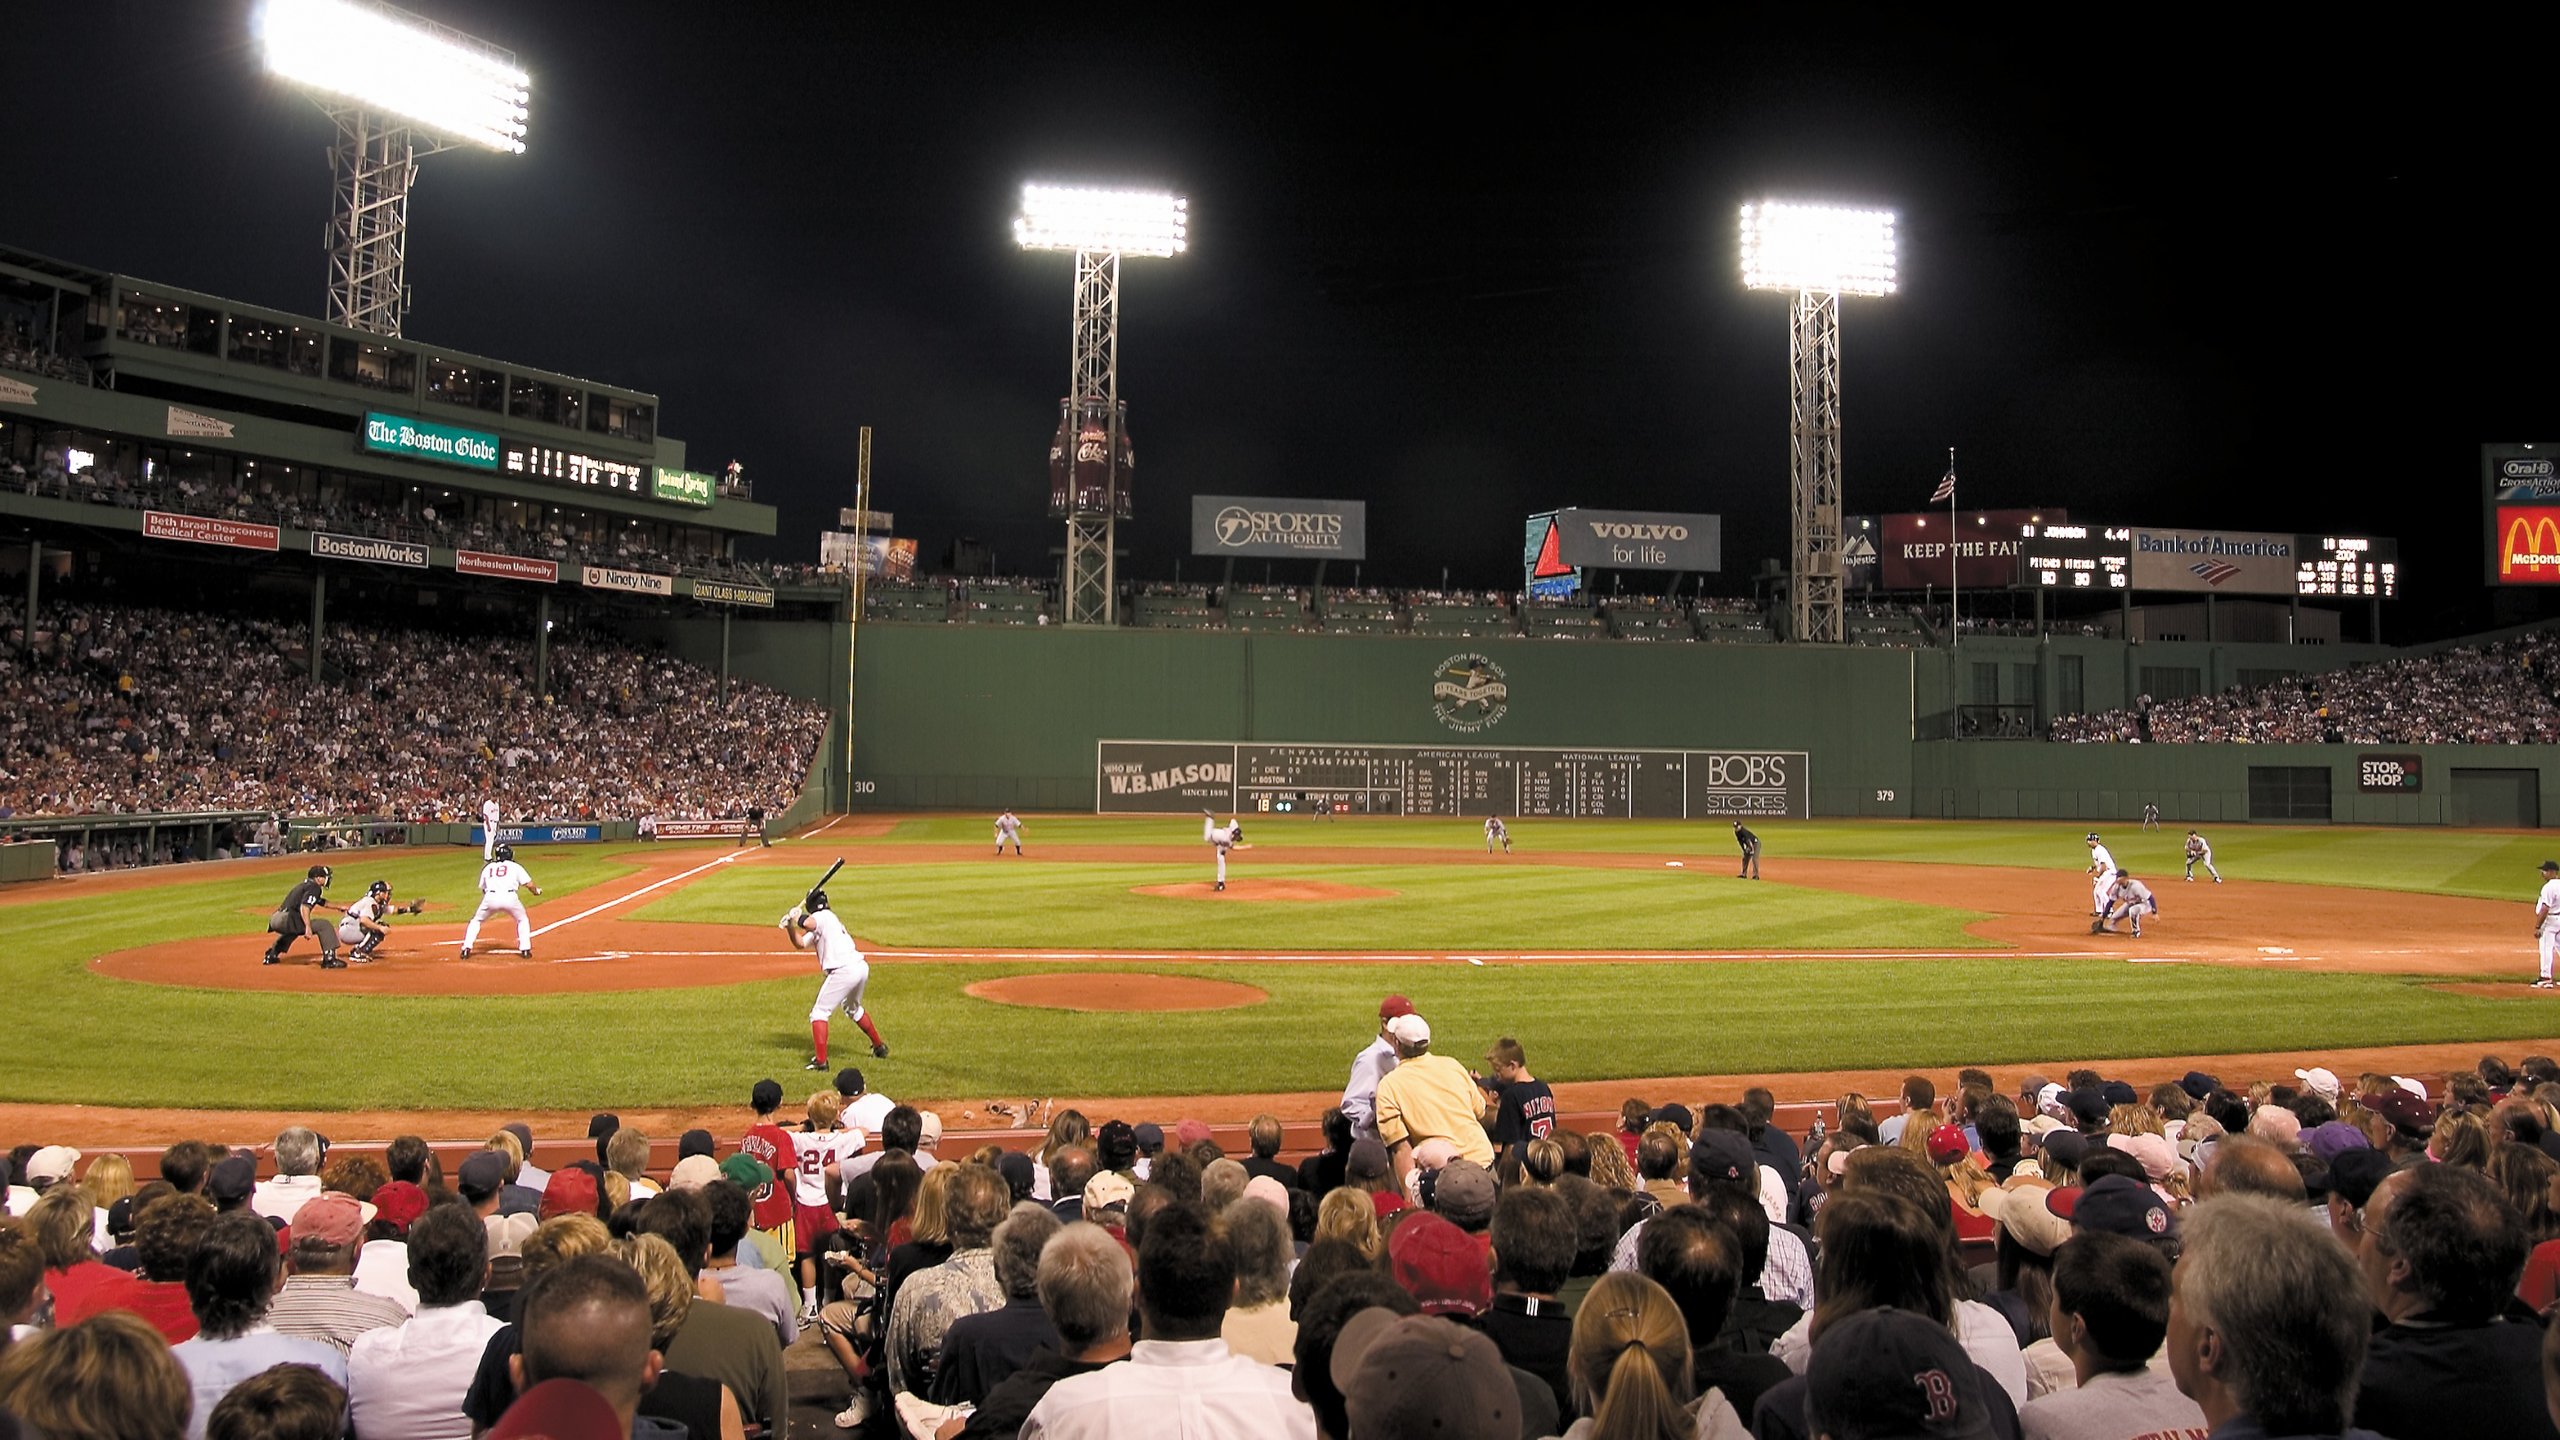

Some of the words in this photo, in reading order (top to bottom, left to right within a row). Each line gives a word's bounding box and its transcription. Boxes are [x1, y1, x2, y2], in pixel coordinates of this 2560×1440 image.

[368, 420, 397, 444] The
[399, 425, 452, 454] Boston
[454, 436, 496, 461] Globe
[627, 466, 641, 477] OUT
[2507, 462, 2550, 474] Oral-B
[590, 468, 599, 484] 2
[610, 472, 619, 487] 0
[629, 475, 637, 491] 2
[684, 473, 708, 498] Spring
[151, 515, 178, 528] Beth
[179, 519, 210, 532] Israel
[213, 522, 275, 540] Deaconess
[1251, 511, 1342, 534] SPORTS
[1589, 522, 1689, 541] VOLVO
[150, 525, 196, 540] Medical
[197, 530, 237, 544] Center
[1251, 532, 1341, 545] AUTHORITY
[318, 535, 424, 565] BostonWorks
[1612, 543, 1635, 564] for
[1640, 545, 1666, 565] life
[1903, 542, 1946, 559] KEEP
[1950, 541, 1984, 557] THE
[2136, 533, 2187, 553] Bank
[2187, 535, 2210, 555] of
[2209, 537, 2290, 558] America
[458, 555, 512, 572] Northeastern
[513, 560, 552, 577] University
[606, 570, 638, 589] Ninety
[640, 574, 662, 590] Nine
[694, 583, 714, 597] GIANT
[713, 585, 733, 600] GLASS
[755, 590, 772, 604] GIANT
[1433, 653, 1467, 678] BOSTON
[1469, 652, 1488, 664] RED
[1489, 661, 1507, 679] SOX
[1432, 703, 1446, 724] THE
[1448, 723, 1481, 734] JIMMY
[1486, 704, 1507, 729] FUND
[1335, 750, 1370, 758] PARK
[1103, 763, 1123, 774] WHO
[1125, 762, 1143, 773] BUT
[1708, 755, 1786, 787] BOB'S
[2362, 761, 2399, 774] STOP
[2397, 766, 2405, 775] &
[854, 780, 875, 793] 310
[1259, 776, 1286, 784] BOSTON
[2362, 773, 2402, 786] SHOP
[1181, 788, 1208, 797] SINCE
[1250, 792, 1259, 800] AT
[1260, 792, 1273, 800] BAT
[1279, 792, 1297, 800] BALL
[1333, 793, 1350, 801] OUT
[1706, 795, 1786, 809] STORES
[1876, 790, 1894, 802] 379
[489, 865, 508, 878] 18
[1530, 1116, 1554, 1140] 7
[803, 1149, 836, 1175] 24
[1913, 1368, 1957, 1421] B
